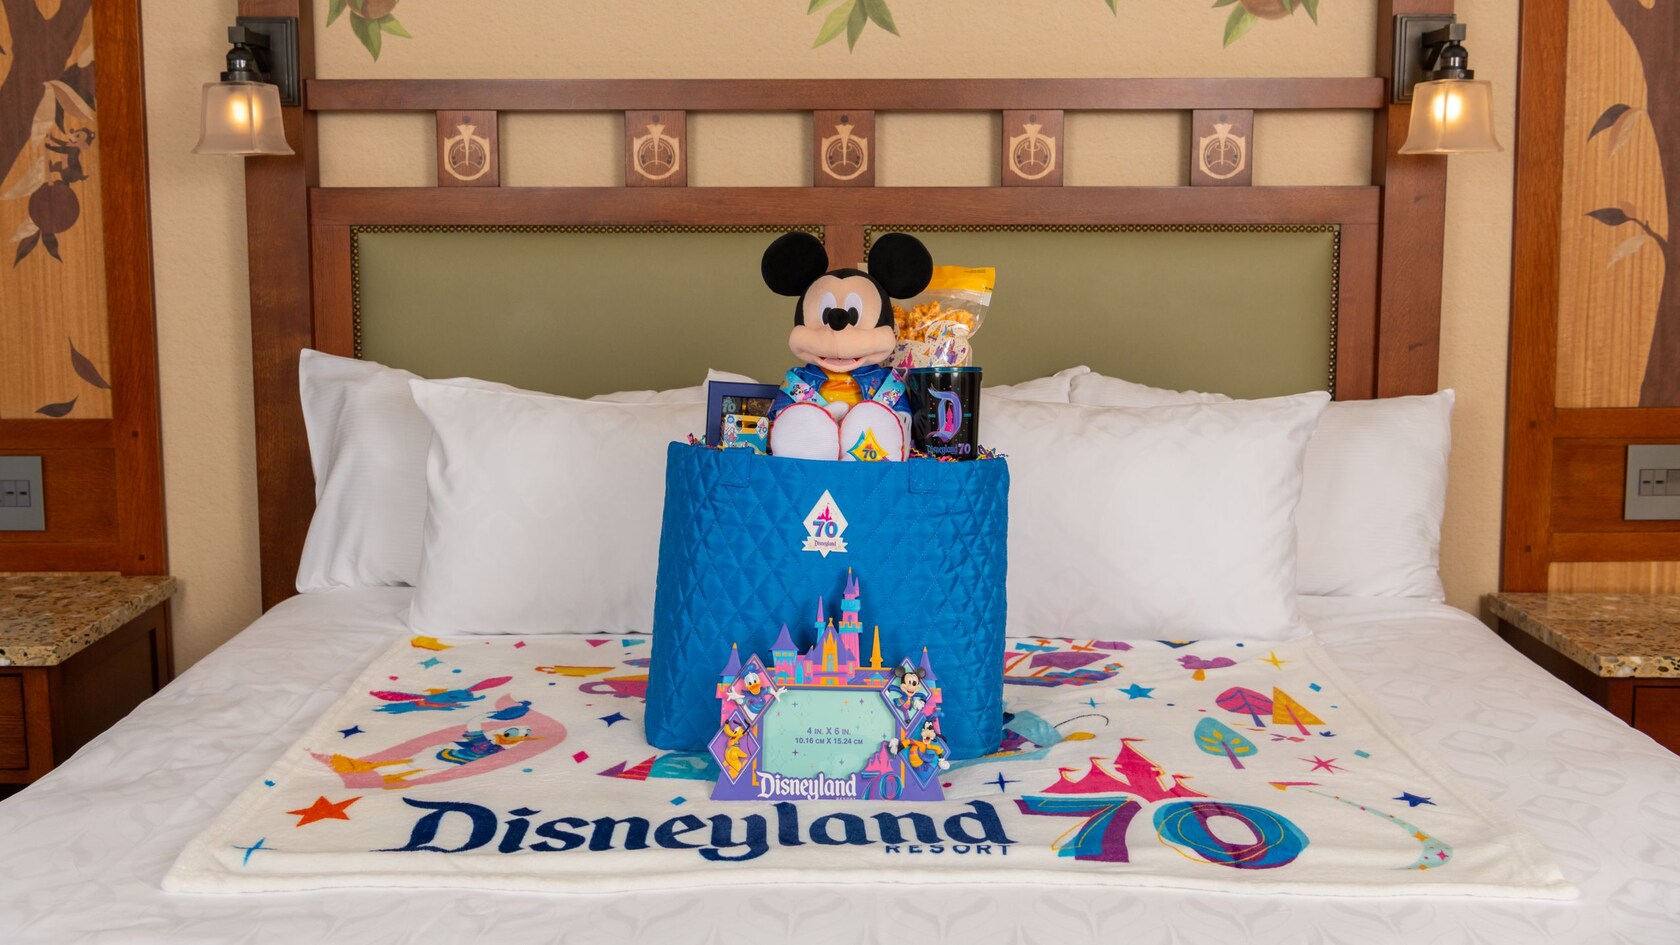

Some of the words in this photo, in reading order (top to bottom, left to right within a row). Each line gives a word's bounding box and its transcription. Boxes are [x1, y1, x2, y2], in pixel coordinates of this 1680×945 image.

[862, 449, 877, 459] 70
[958, 443, 971, 454] 70
[813, 520, 838, 538] 70
[807, 727, 812, 735] 4
[826, 727, 832, 735] X
[834, 727, 840, 735] 6
[795, 737, 814, 745] 10.16
[756, 771, 857, 800] Disneyland
[861, 771, 903, 800] 70
[369, 796, 1019, 861] Disneyland
[1013, 795, 1310, 869] 70
[885, 844, 1011, 855] RESORT
